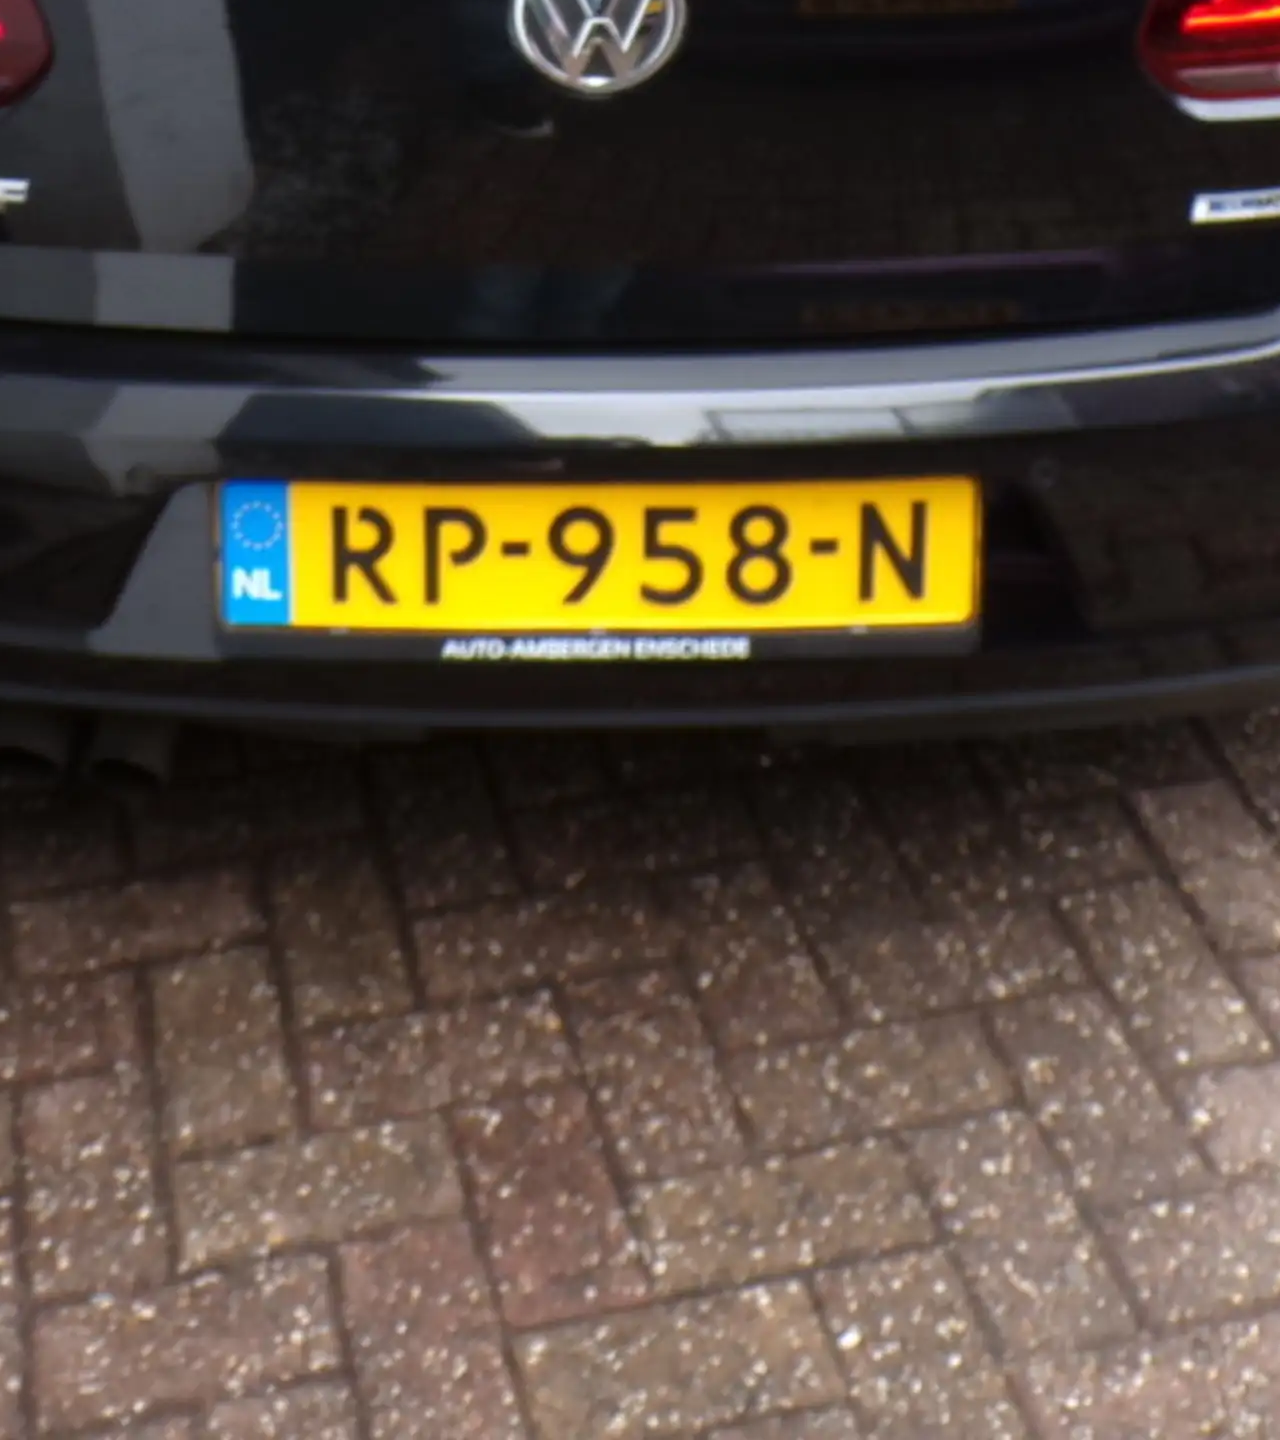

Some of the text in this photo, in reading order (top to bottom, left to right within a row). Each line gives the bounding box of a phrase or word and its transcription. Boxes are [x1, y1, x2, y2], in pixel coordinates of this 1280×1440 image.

[331, 499, 929, 607] RP-958-N
[231, 566, 283, 601] NL
[634, 636, 752, 660] ENSCHEDE
